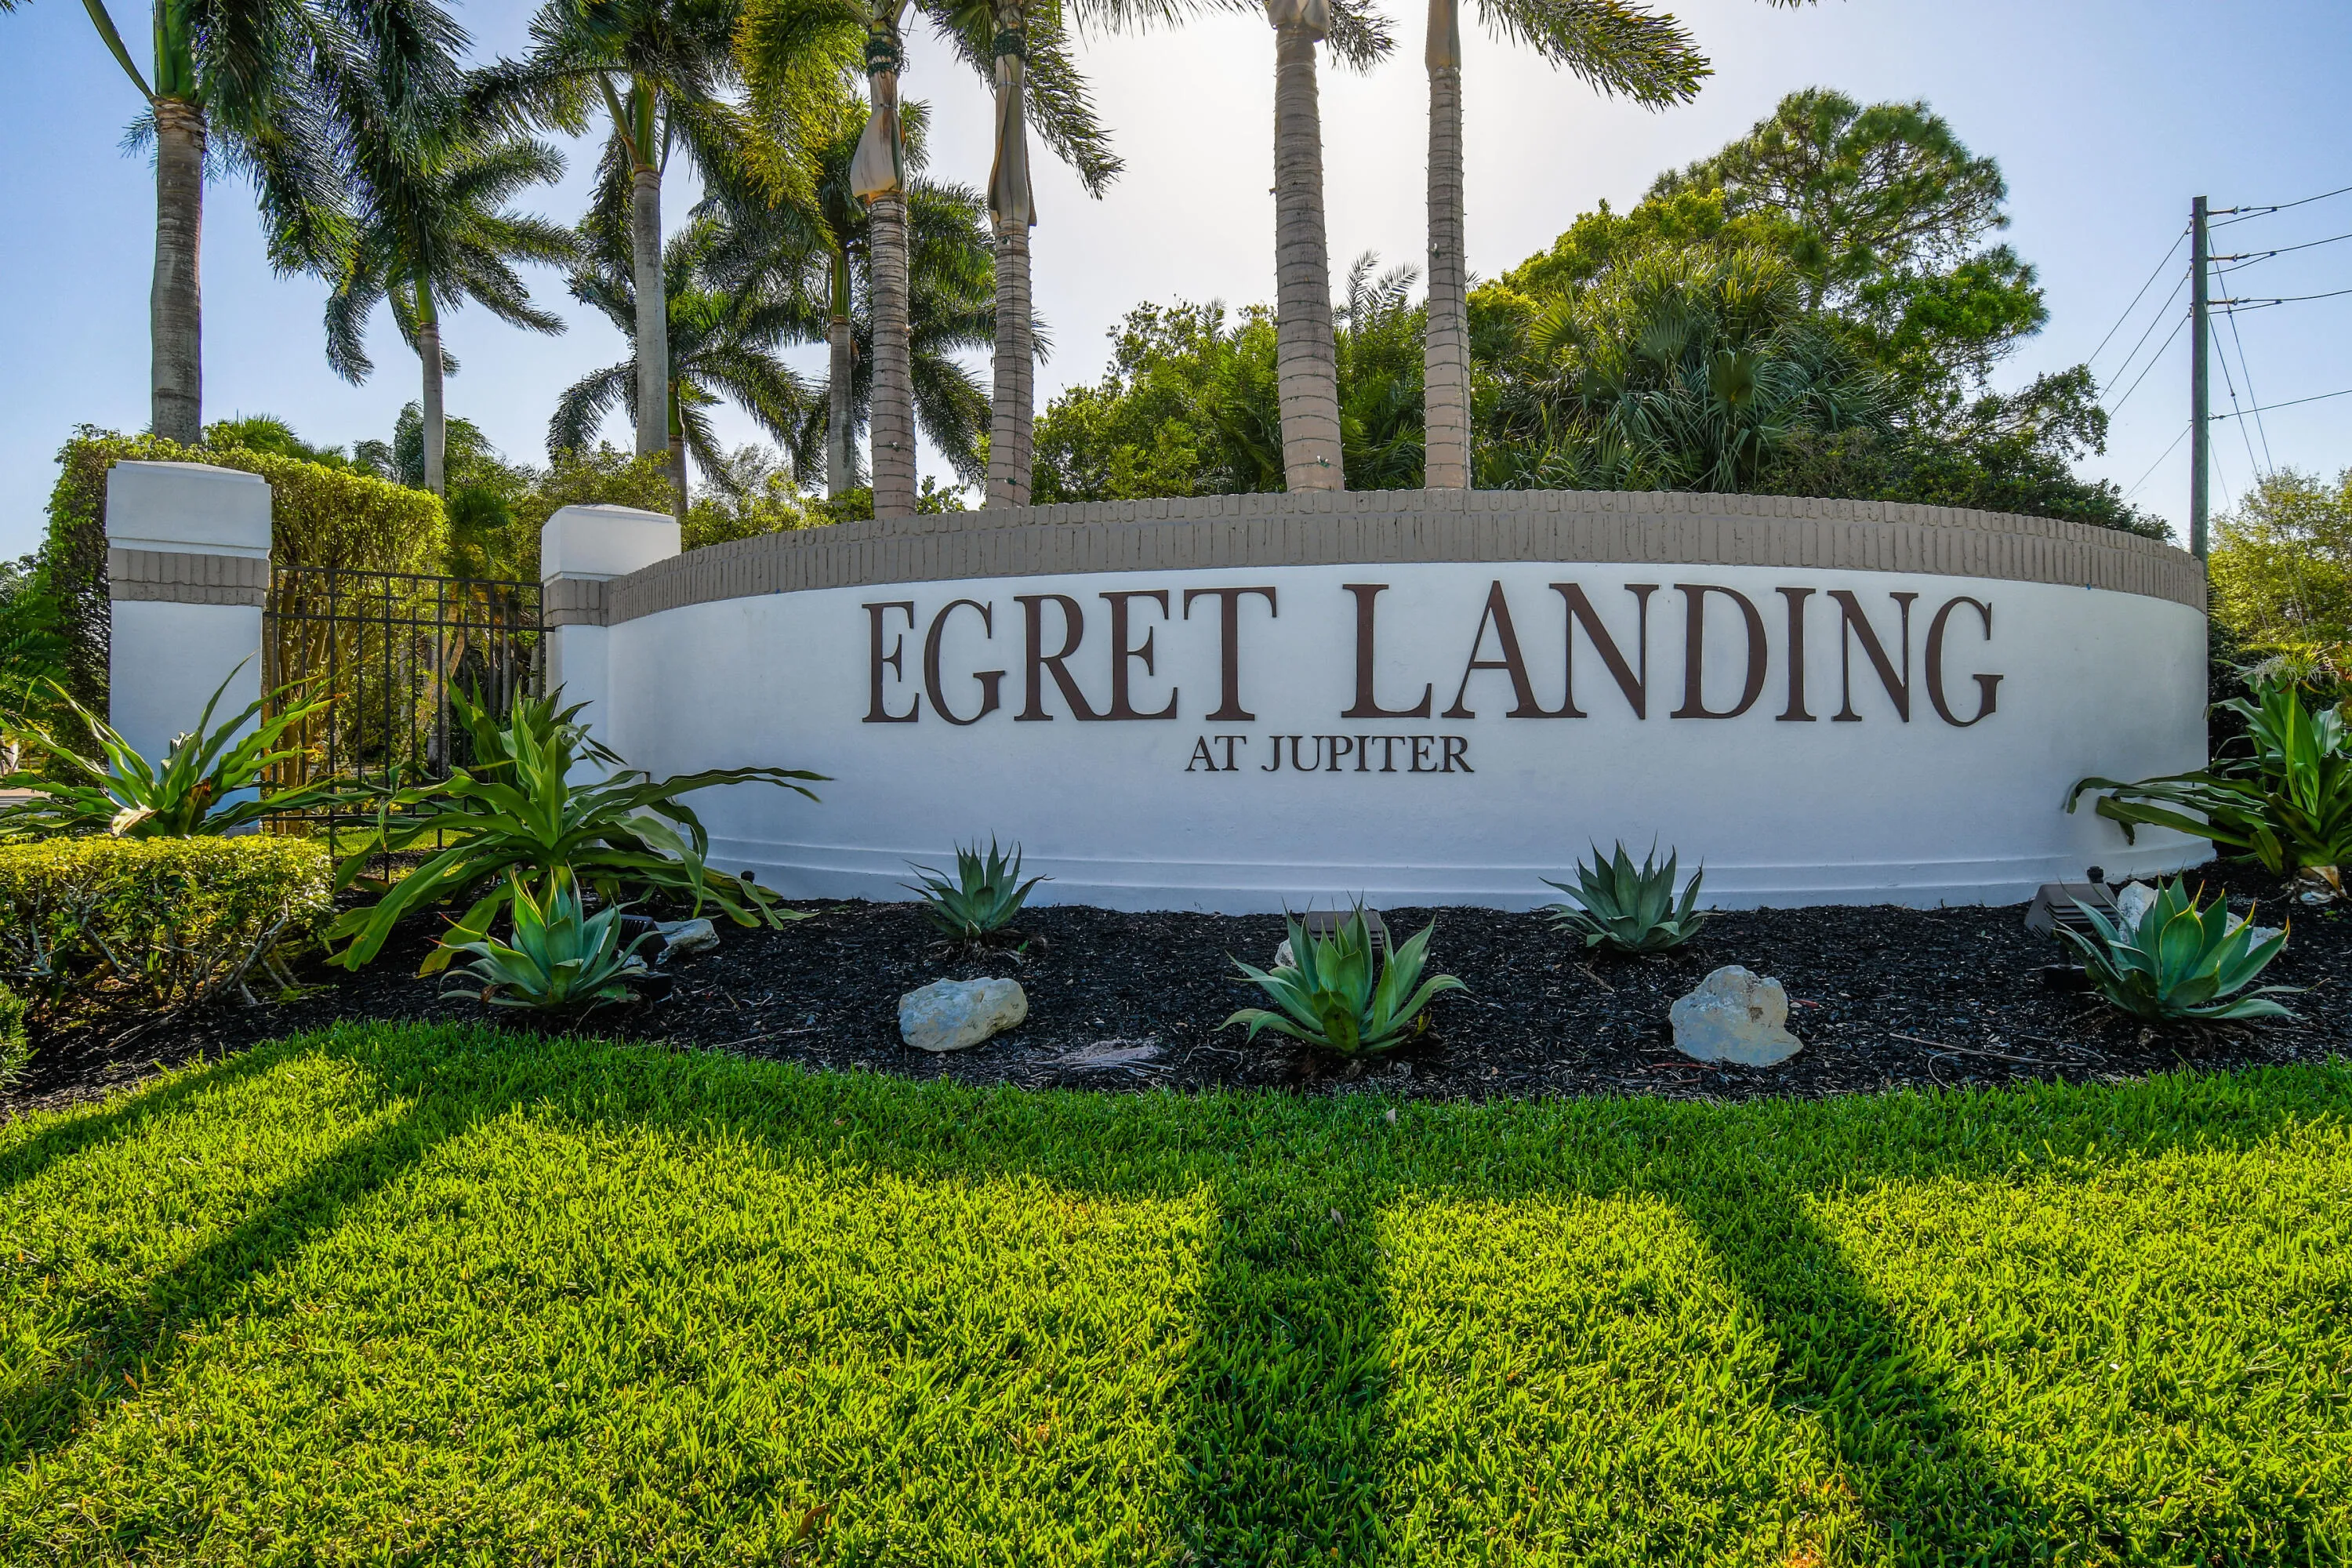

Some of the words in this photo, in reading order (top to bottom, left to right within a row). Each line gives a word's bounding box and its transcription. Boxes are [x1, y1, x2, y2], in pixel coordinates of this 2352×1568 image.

[861, 586, 1278, 726] EGRET
[1340, 579, 2004, 728] LANDING
[1184, 735, 1247, 772] AT
[1260, 735, 1475, 774] JUPITER
